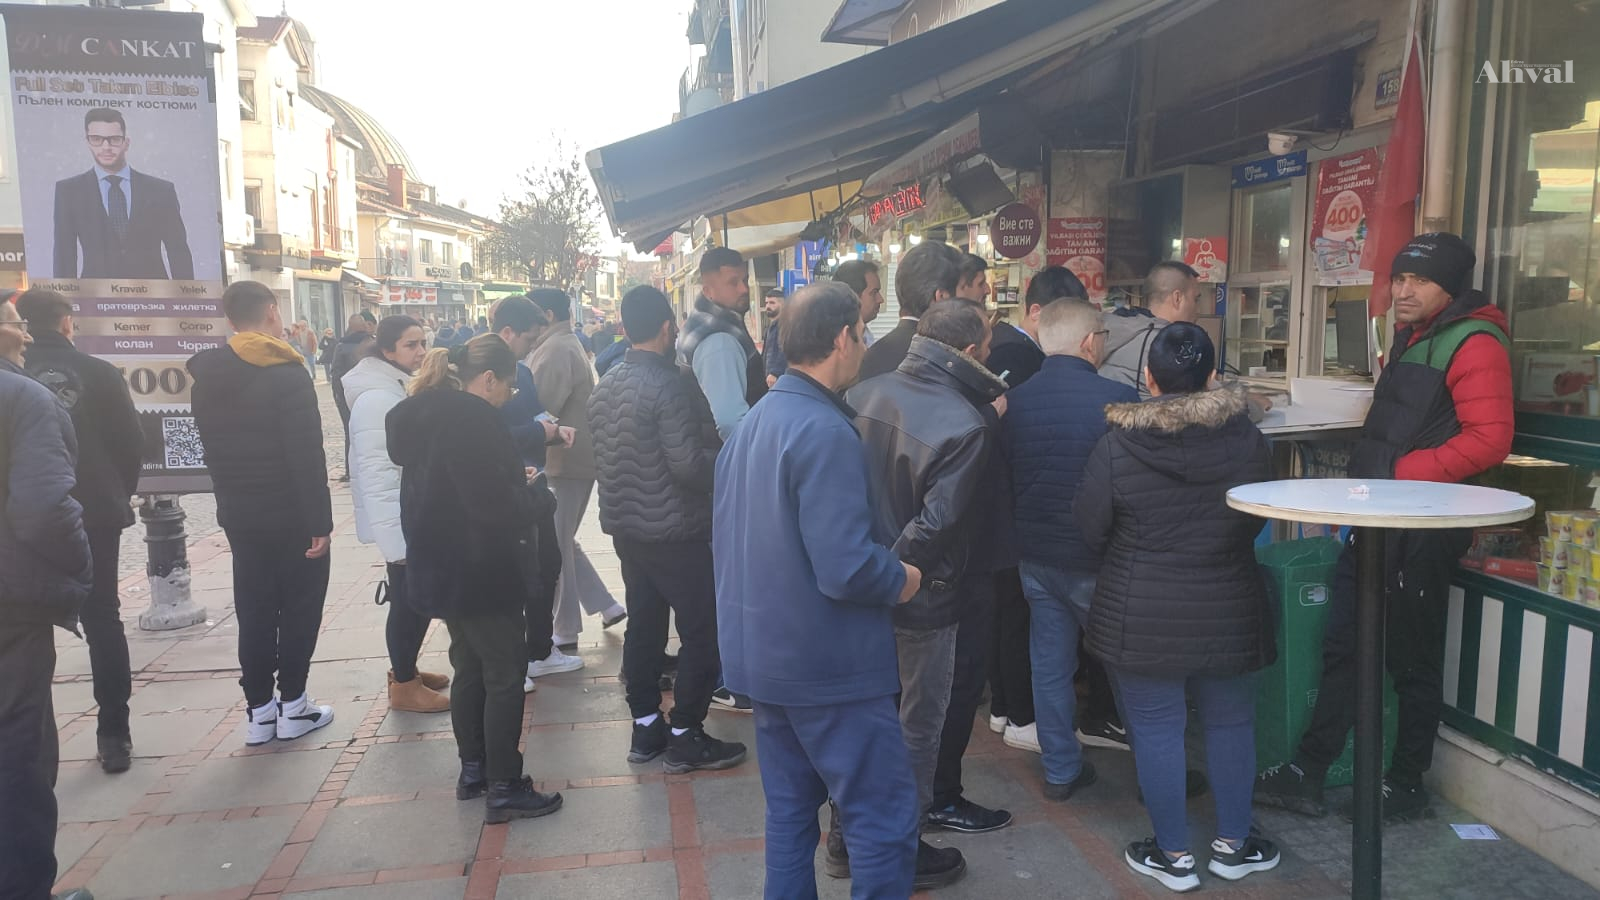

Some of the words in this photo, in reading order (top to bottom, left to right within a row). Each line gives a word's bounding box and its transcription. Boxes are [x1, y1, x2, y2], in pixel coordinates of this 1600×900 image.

[81, 37, 196, 58] CANKAT
[15, 76, 46, 92] Full
[146, 80, 199, 97] Elbise
[18, 95, 63, 106] Пълен
[66, 97, 132, 109] комплект
[136, 99, 197, 110] костюми
[1327, 204, 1360, 226] 400
[999, 217, 1017, 231] Вие
[1018, 218, 1034, 230] сте
[1003, 235, 1031, 246] важни
[111, 284, 147, 294] Kravat
[179, 285, 207, 294] Yelek
[97, 302, 165, 311] пратовръзка
[173, 303, 217, 311] жилетка
[114, 322, 151, 332] Kemer
[179, 322, 213, 333] Çorap
[115, 340, 153, 349] колан
